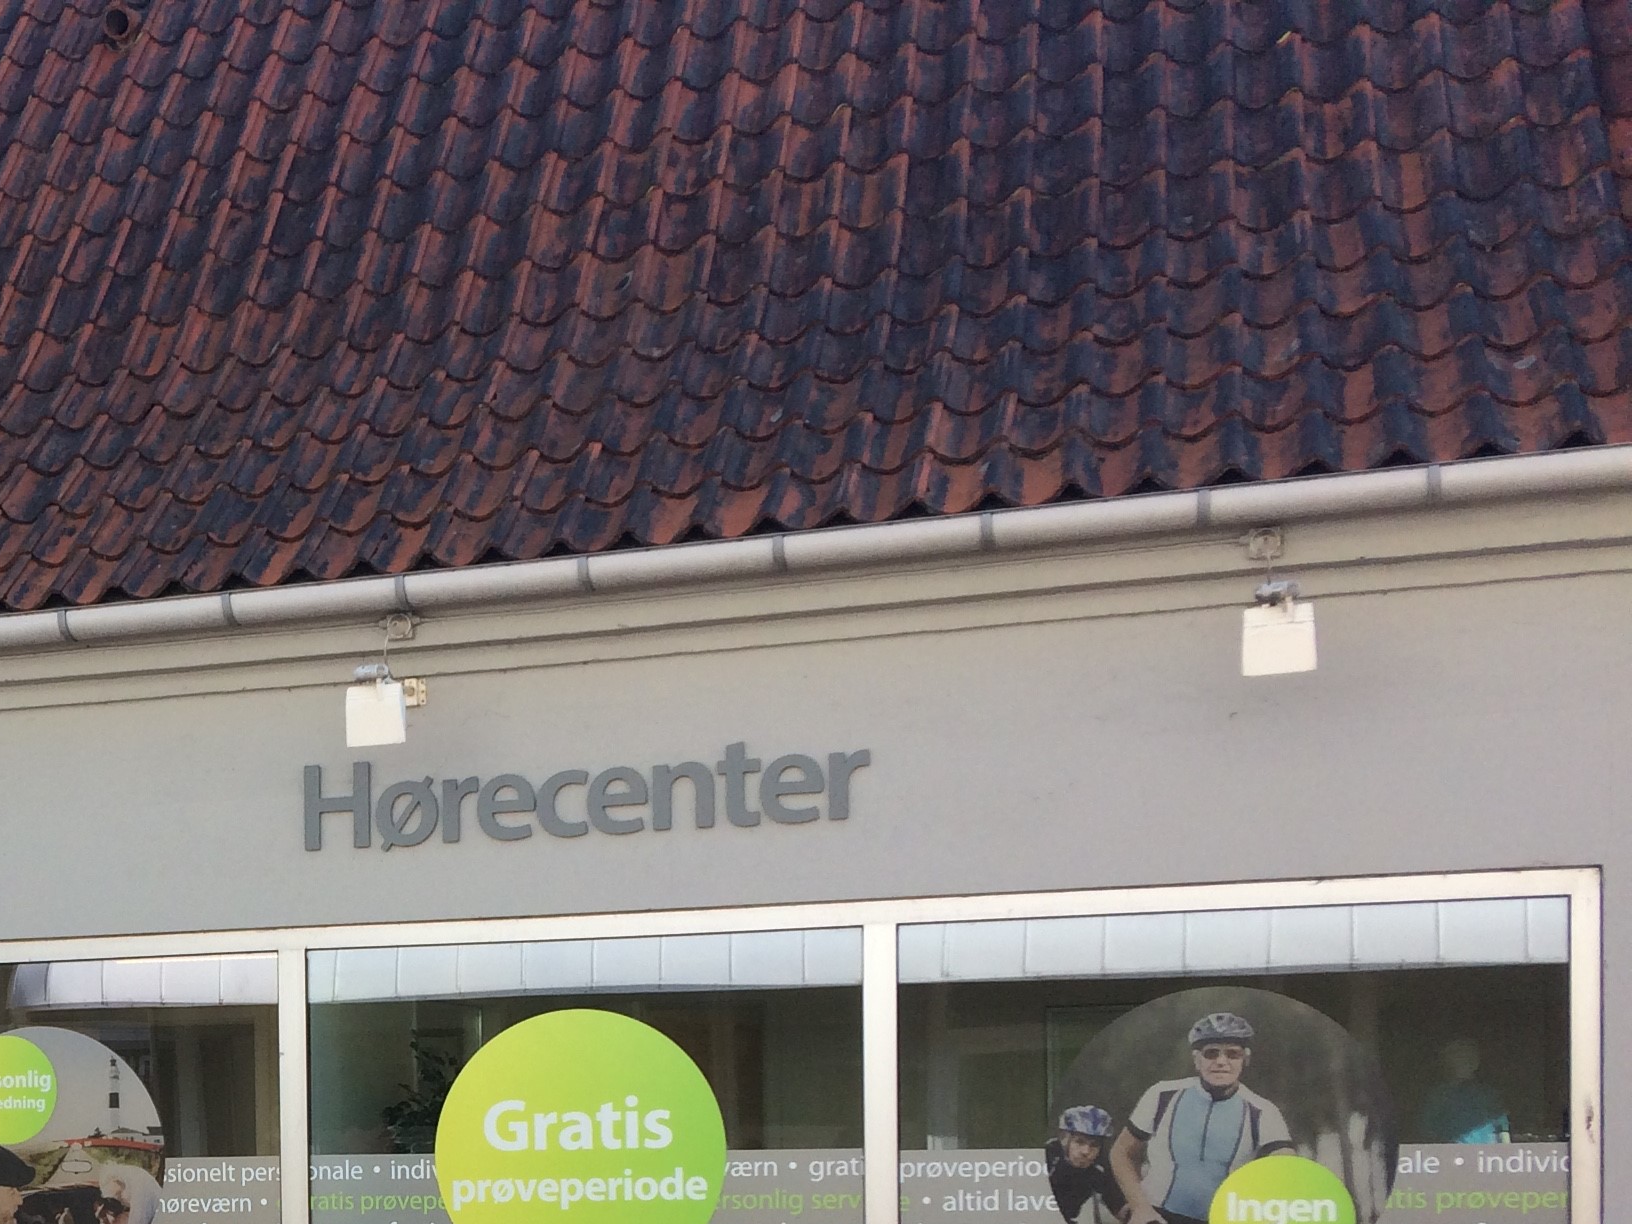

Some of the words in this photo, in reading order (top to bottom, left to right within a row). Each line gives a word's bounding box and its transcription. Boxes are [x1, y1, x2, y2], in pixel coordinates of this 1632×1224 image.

[304, 741, 871, 852] Hørecenter
[483, 1095, 674, 1153] Gratis
[809, 1158, 864, 1181] grati
[900, 1156, 1048, 1184] prøveperio
[451, 1167, 709, 1211] prøveperiode
[942, 1190, 999, 1212] altid
